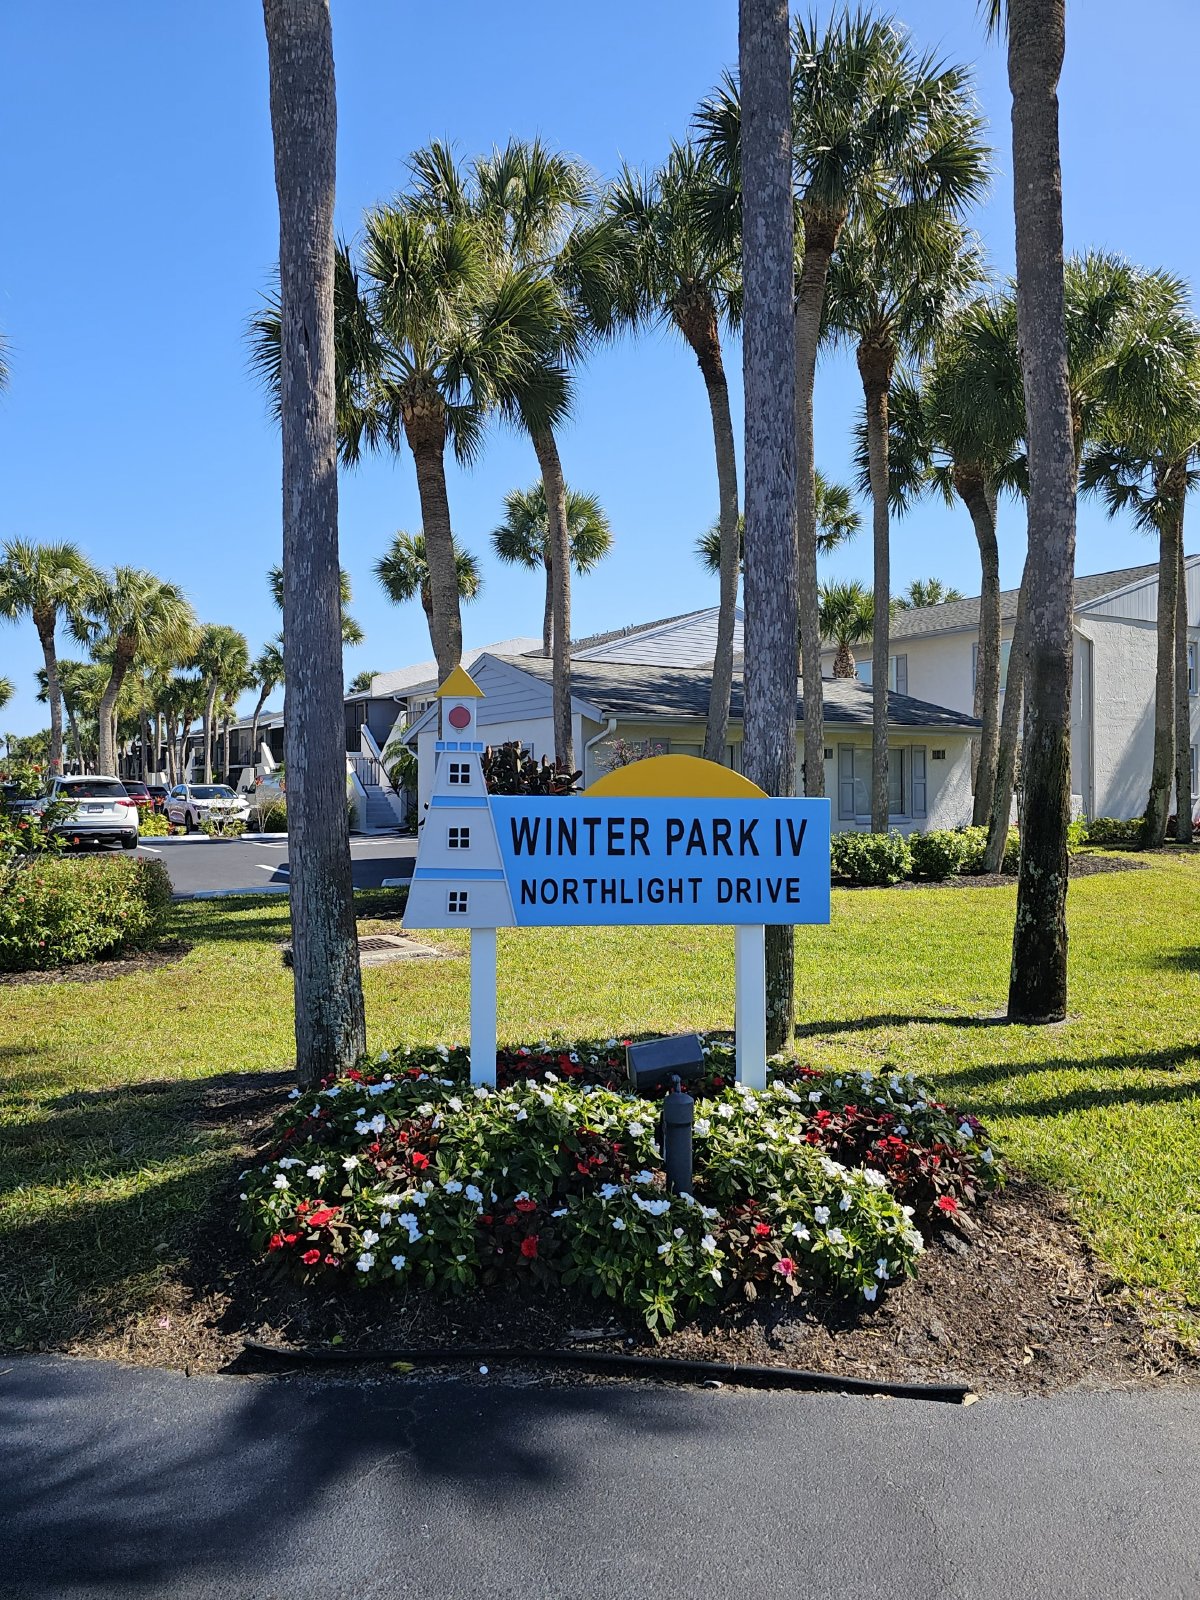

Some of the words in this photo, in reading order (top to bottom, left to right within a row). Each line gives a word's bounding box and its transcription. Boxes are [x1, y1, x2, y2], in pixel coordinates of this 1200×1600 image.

[511, 817, 651, 856] WINTER
[667, 818, 760, 857] PARK
[776, 818, 808, 857] IV
[520, 877, 703, 905] NORTHLIGHT
[717, 877, 801, 904] DRIVE
